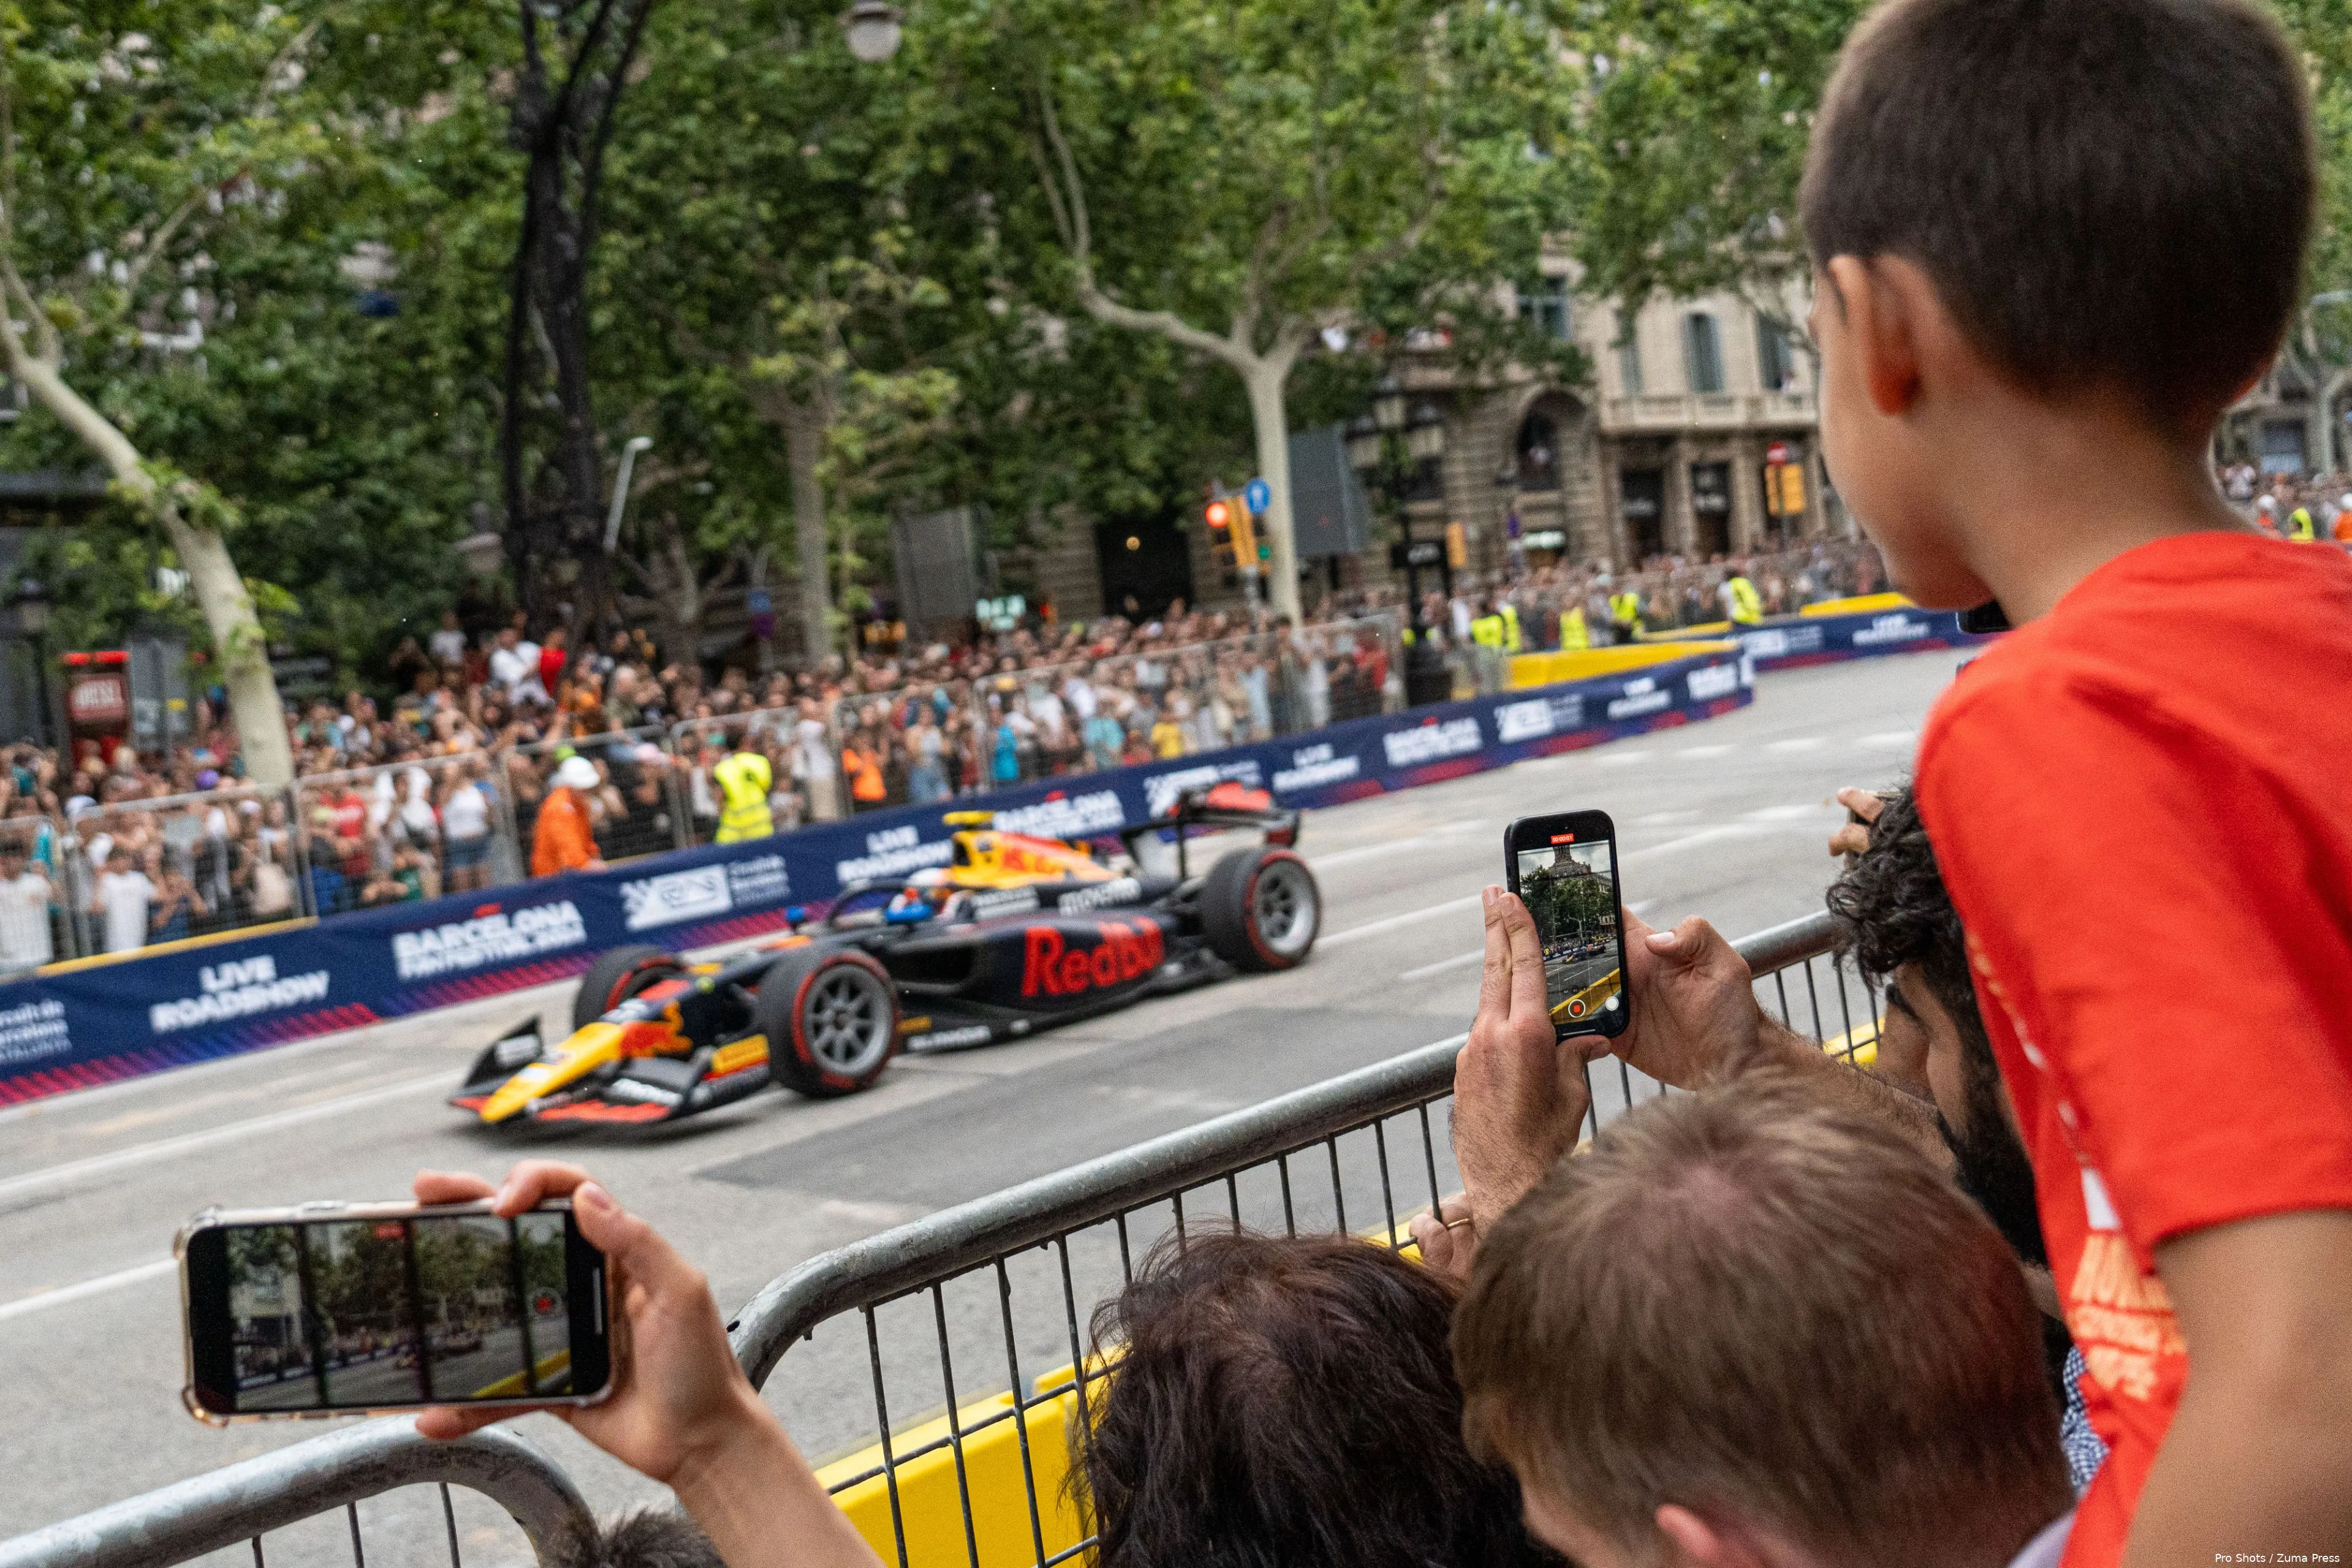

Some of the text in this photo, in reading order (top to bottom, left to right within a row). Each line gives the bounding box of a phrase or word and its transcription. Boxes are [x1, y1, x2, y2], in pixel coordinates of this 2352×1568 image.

[392, 900, 585, 958] BARCELONA
[149, 971, 330, 1033] ROADSHOW
[199, 954, 276, 993] LIVE
